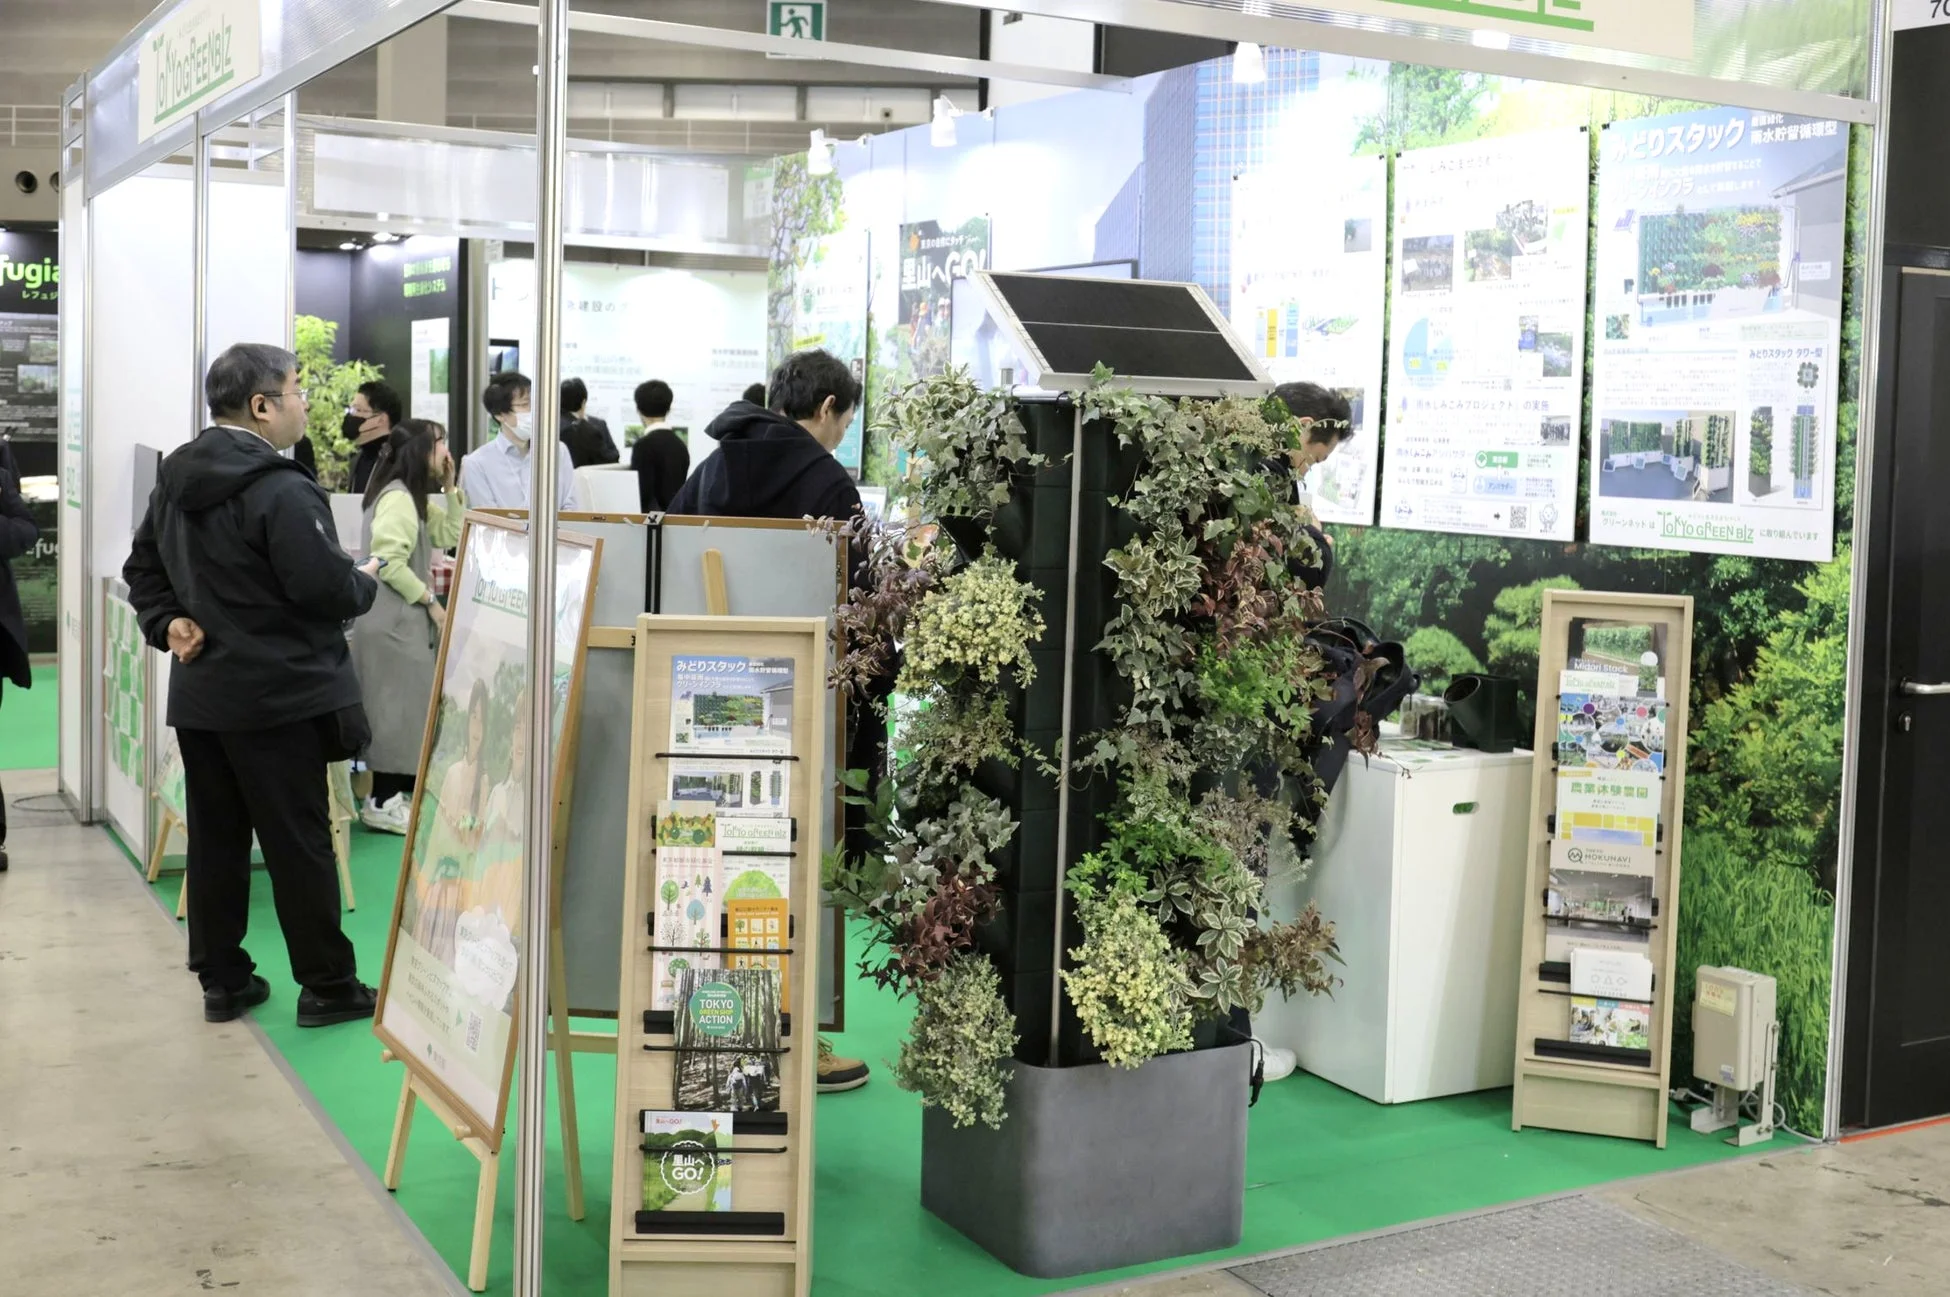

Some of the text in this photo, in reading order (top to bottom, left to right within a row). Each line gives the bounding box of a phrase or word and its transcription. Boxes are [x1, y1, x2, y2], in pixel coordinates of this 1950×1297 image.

[1608, 118, 1745, 162] みどりスタック
[676, 660, 746, 673] みどりスタック
[1571, 782, 1648, 798] 農業体験農園
[1584, 854, 1631, 863] MOKUNAVI
[699, 999, 734, 1009] TOKYO
[699, 1015, 733, 1024] ACTION
[672, 1154, 705, 1166] 里山へ
[672, 1167, 704, 1180] GO!
